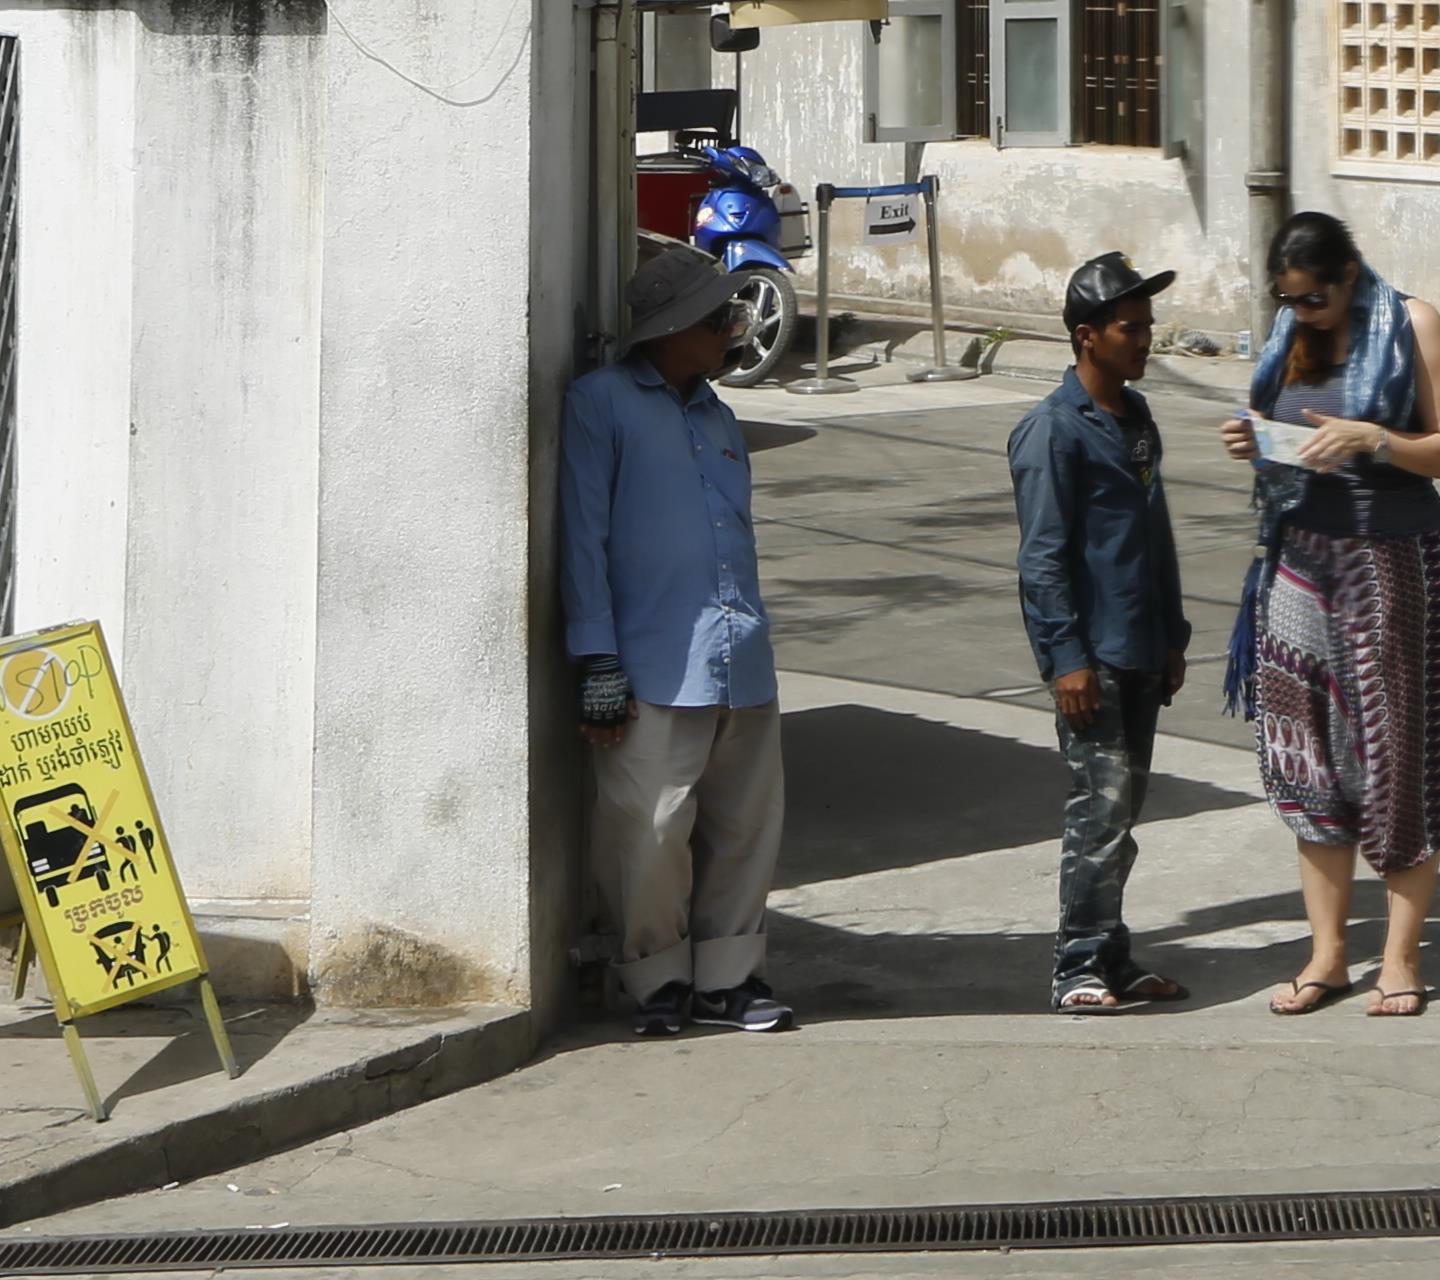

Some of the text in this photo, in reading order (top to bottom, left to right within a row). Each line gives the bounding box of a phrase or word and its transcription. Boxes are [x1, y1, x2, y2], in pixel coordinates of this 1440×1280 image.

[880, 203, 909, 220] Exit
[11, 705, 92, 753] ហាមឈប់
[64, 884, 144, 934] ច្រកចូល
